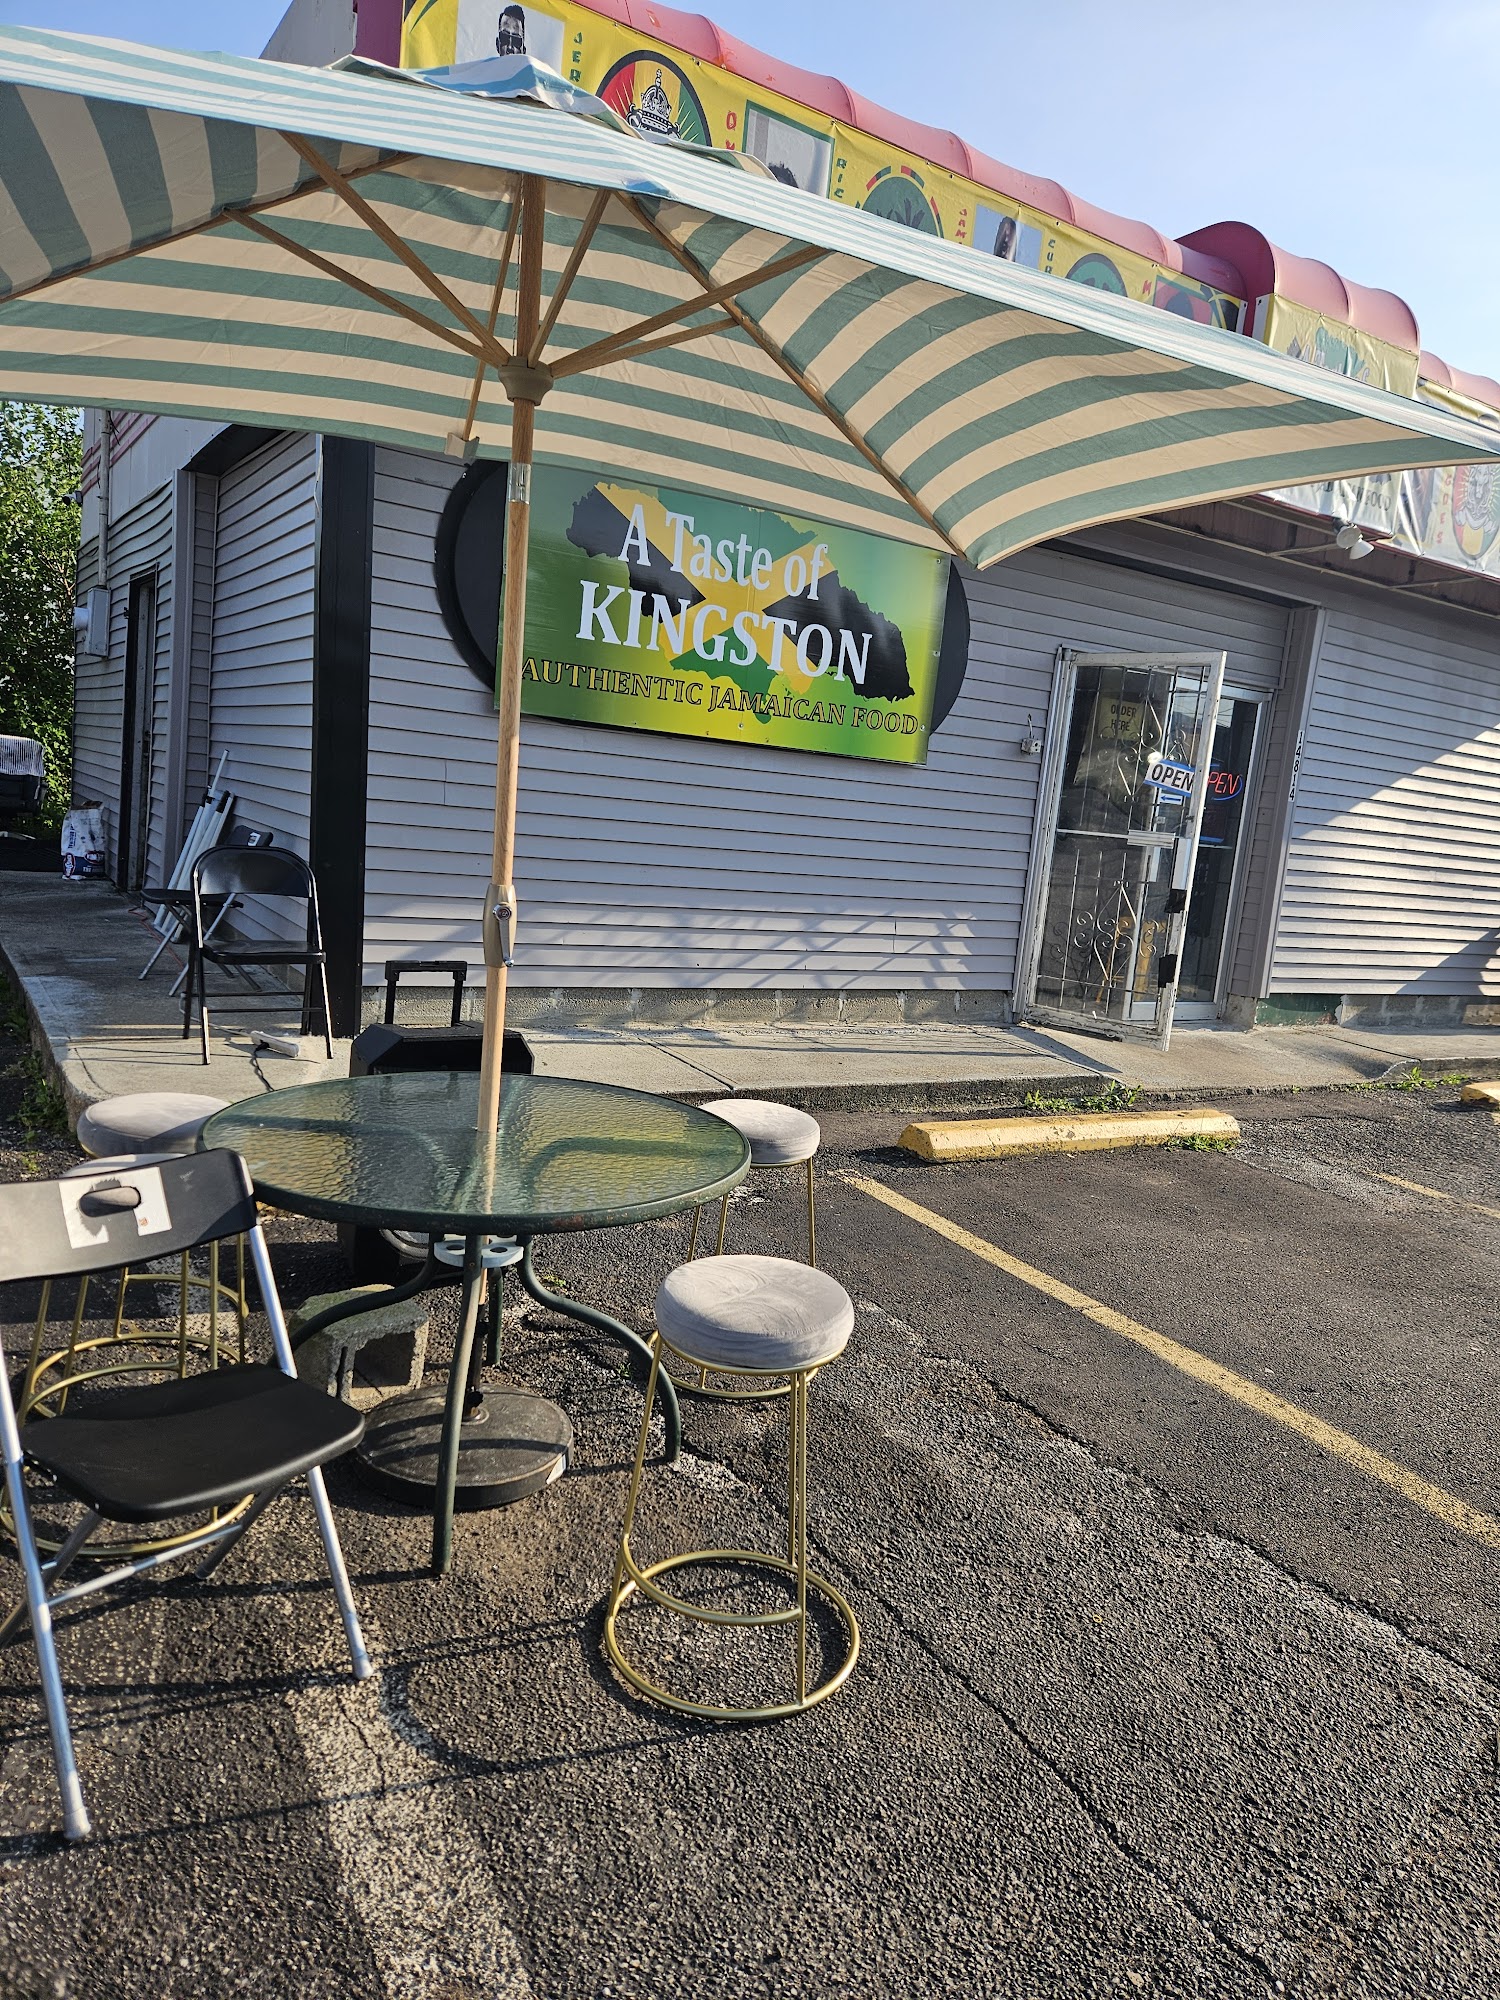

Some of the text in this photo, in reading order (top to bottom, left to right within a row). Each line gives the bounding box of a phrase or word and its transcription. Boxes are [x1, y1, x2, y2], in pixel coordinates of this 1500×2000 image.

[954, 208, 968, 244] JAM
[618, 503, 829, 601] A Taste of
[575, 580, 873, 685] KINGSTON
[521, 656, 919, 735] AUTHENTIC JAMAICAN FOOD
[1151, 763, 1195, 791] OPEN
[1207, 771, 1240, 795] PEN
